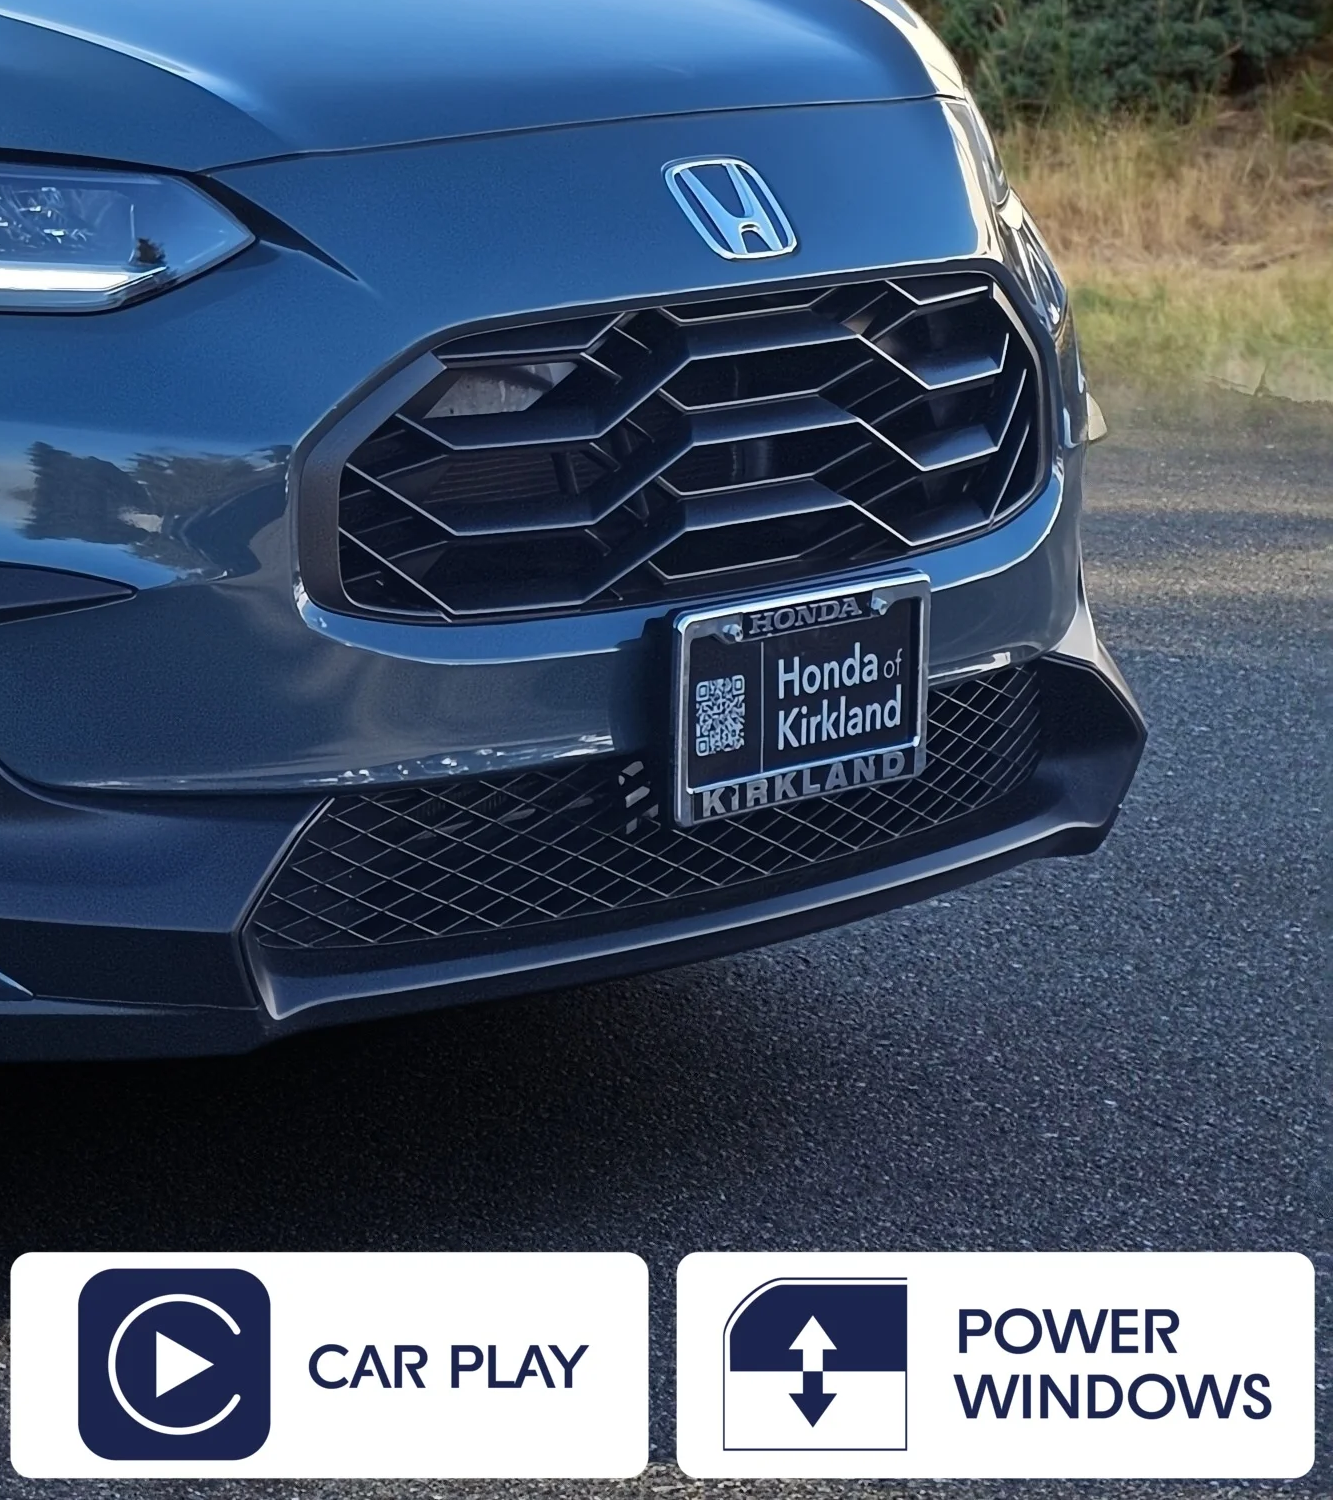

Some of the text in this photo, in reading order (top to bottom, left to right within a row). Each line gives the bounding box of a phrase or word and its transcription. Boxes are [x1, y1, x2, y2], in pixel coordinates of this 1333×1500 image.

[748, 597, 863, 635] HONDA
[777, 641, 903, 700] Honda of
[777, 683, 902, 751] Kirkland
[701, 751, 906, 818] KIRKLAND
